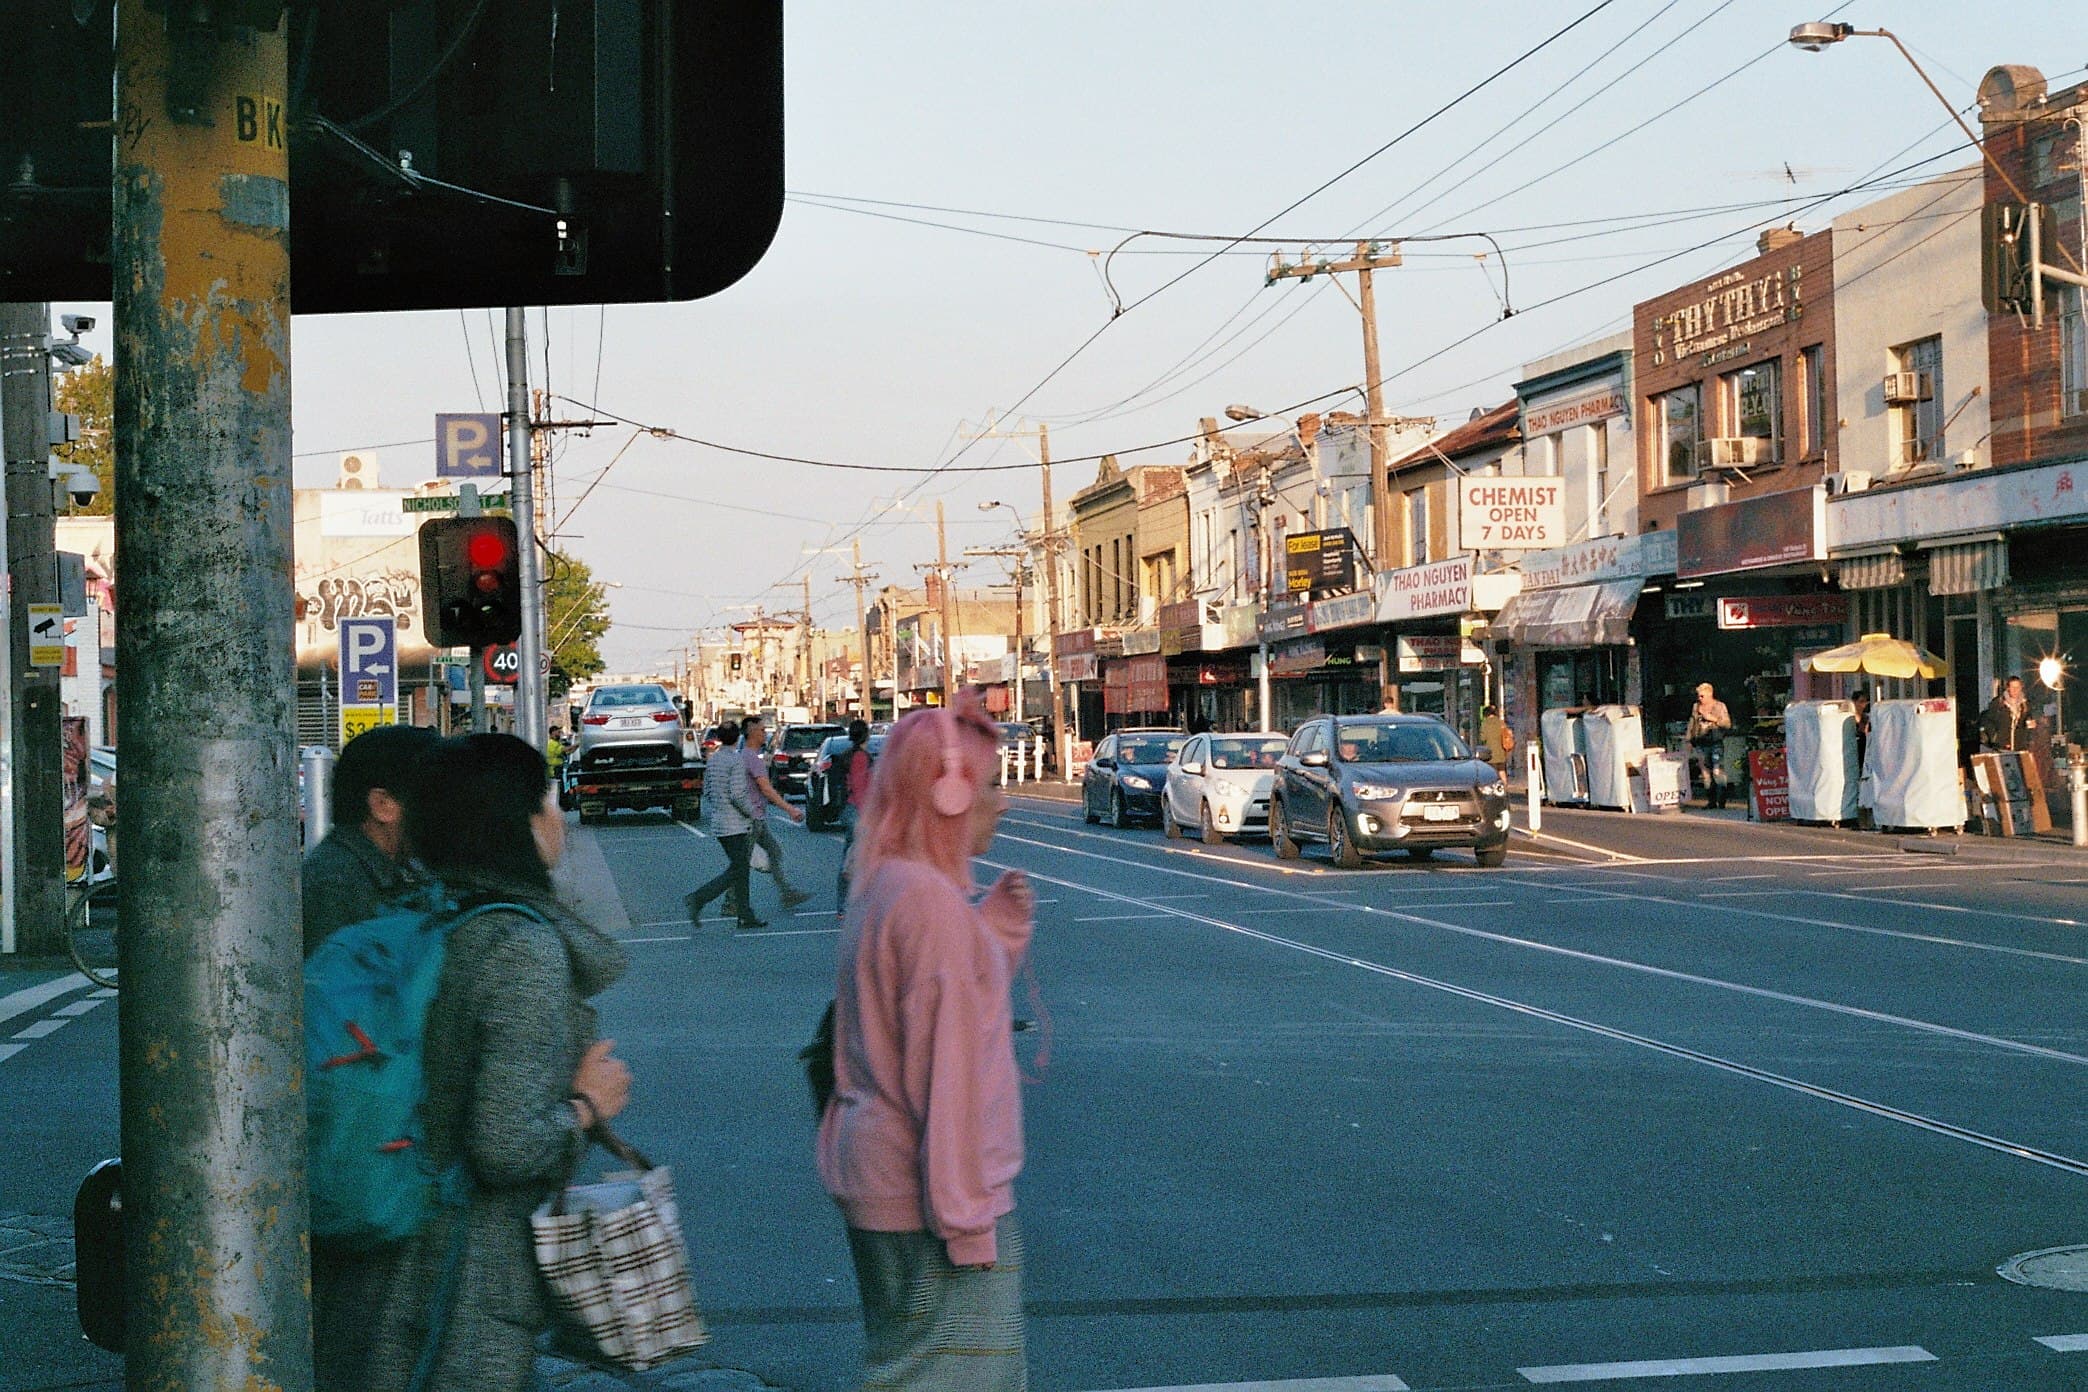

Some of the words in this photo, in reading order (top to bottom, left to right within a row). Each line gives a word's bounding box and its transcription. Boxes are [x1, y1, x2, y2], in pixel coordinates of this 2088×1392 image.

[1669, 297, 1718, 345] THY
[1720, 275, 1772, 326] THY
[1528, 415, 1547, 433] THAO
[1549, 406, 1579, 427] NGUYEN
[1580, 393, 1624, 419] PHARMACY
[446, 420, 489, 467] P
[403, 497, 461, 511] NICHOLSO
[1469, 487, 1557, 506] CHEMIST
[1489, 508, 1537, 522] OPEN
[1482, 526, 1492, 540] 7
[1501, 526, 1546, 540] DAYS
[1393, 571, 1420, 592] THAO
[1424, 563, 1467, 586] NGUYEN
[1411, 586, 1467, 611] PHARMACY
[349, 625, 386, 673] P
[493, 652, 518, 670] 40
[1655, 789, 1687, 802] OPEN
[1765, 807, 1789, 817] OPE
